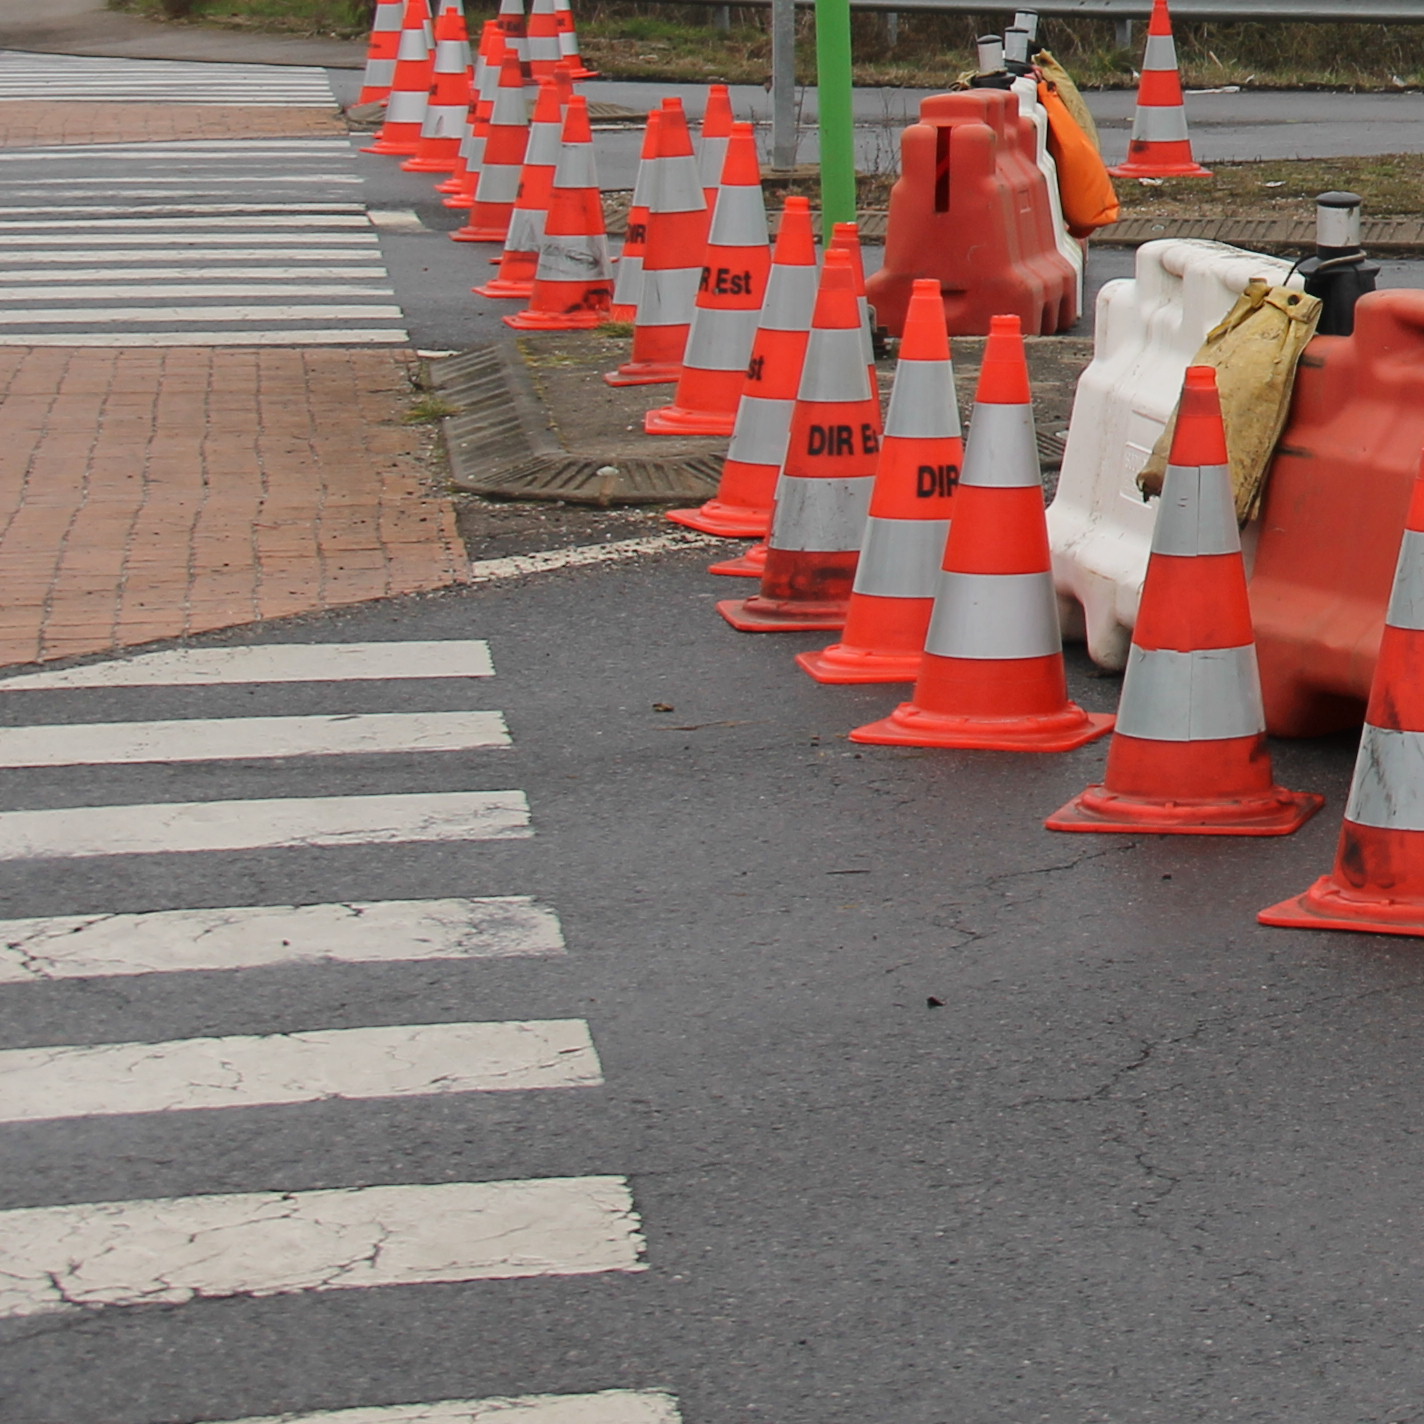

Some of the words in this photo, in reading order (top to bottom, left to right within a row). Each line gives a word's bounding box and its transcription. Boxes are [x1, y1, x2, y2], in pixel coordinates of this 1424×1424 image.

[715, 267, 752, 295] Est
[807, 424, 854, 456] DIR
[917, 465, 959, 498] DIR
